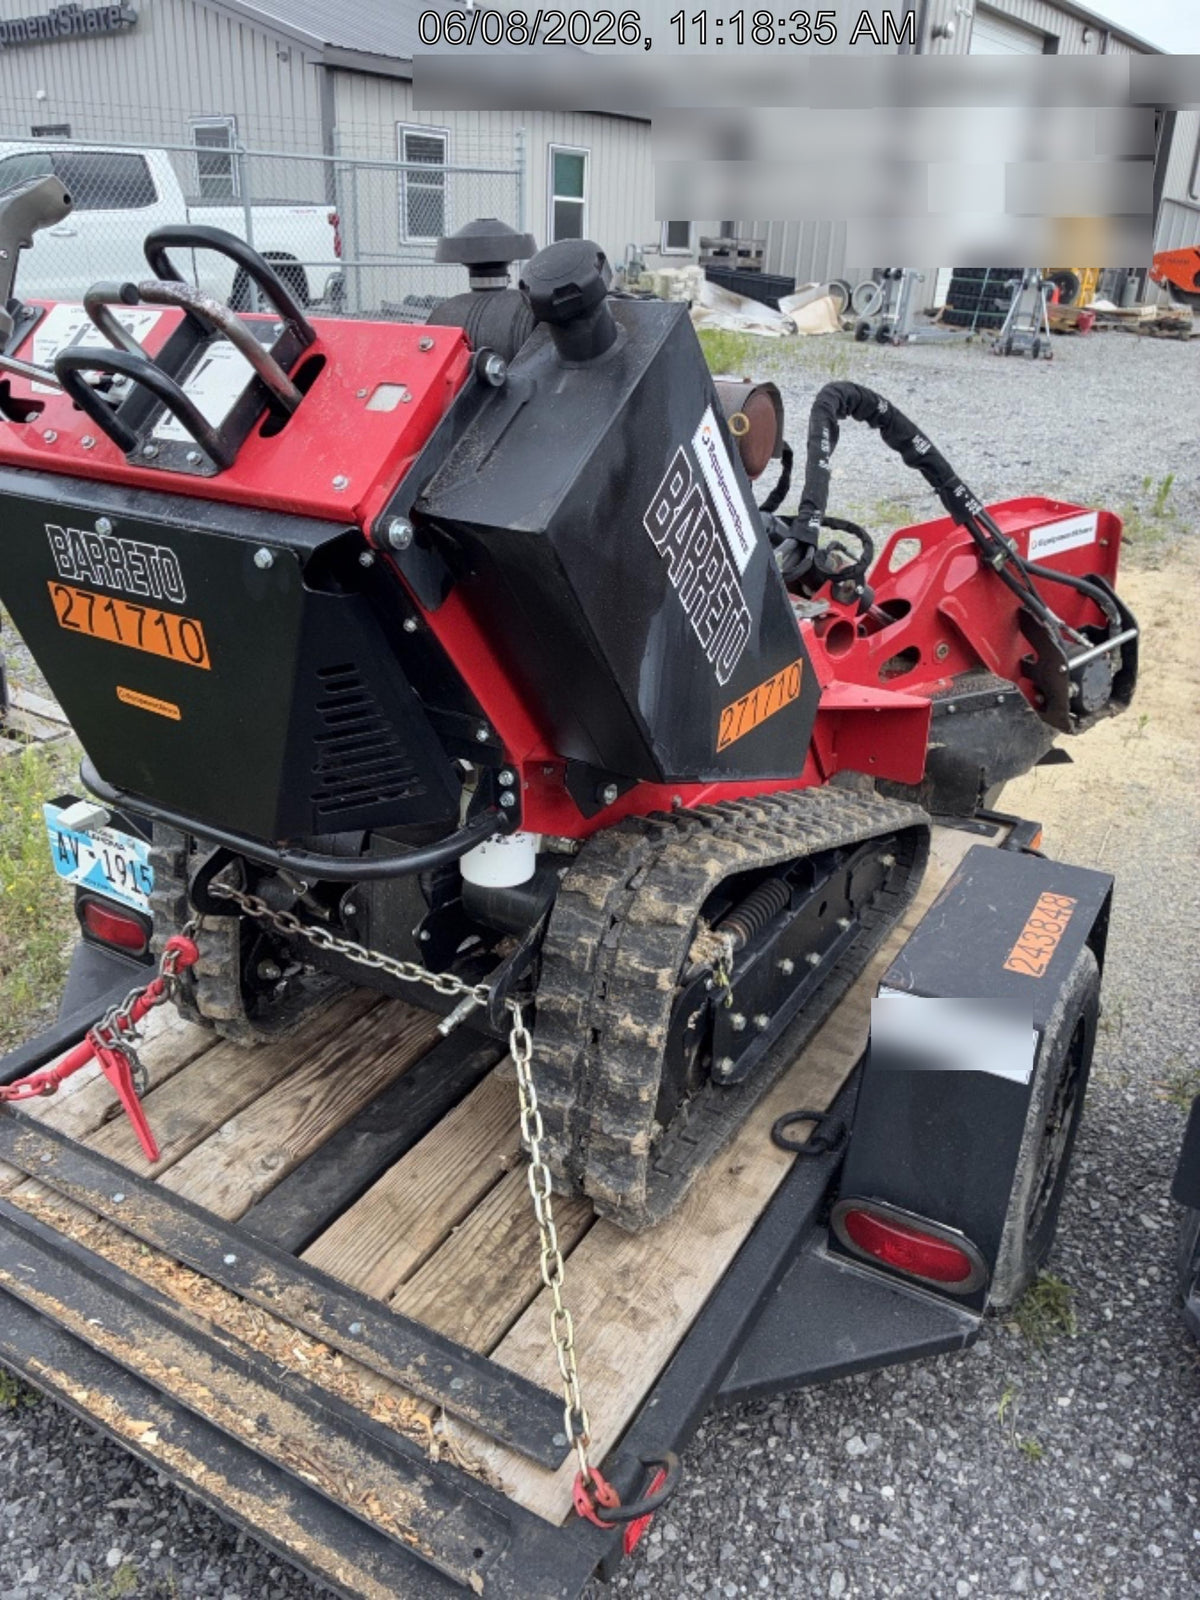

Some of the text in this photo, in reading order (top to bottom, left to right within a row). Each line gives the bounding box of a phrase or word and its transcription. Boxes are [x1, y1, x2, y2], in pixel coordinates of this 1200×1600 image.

[44, 523, 188, 605] BARRETO
[643, 445, 752, 687] BARRETO
[54, 585, 205, 664] 271710
[719, 663, 800, 747] 271710
[1008, 895, 1074, 975] 243848
